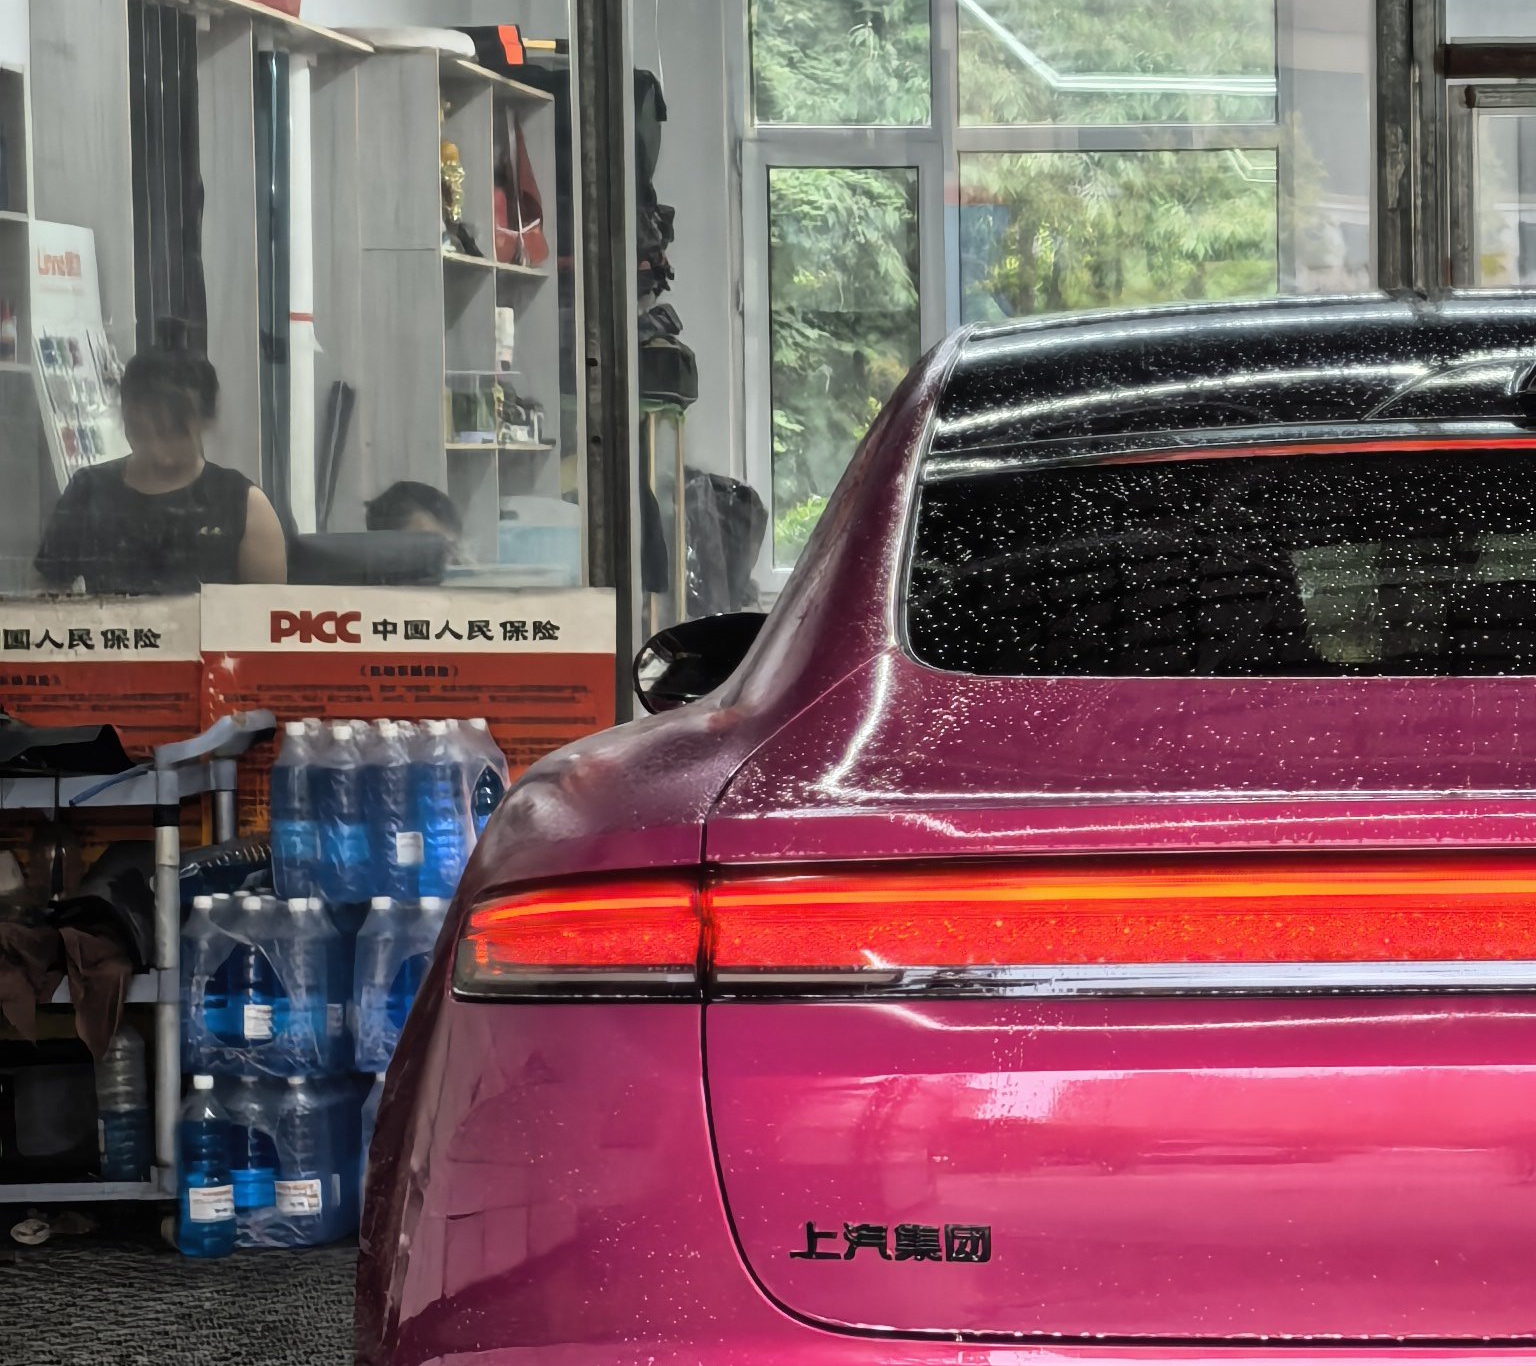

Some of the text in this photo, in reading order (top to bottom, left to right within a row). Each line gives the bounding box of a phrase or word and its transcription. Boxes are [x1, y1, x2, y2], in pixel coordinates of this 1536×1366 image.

[270, 610, 560, 643] PICC 中国人民保险
[790, 1221, 991, 1262] 上汽集团
